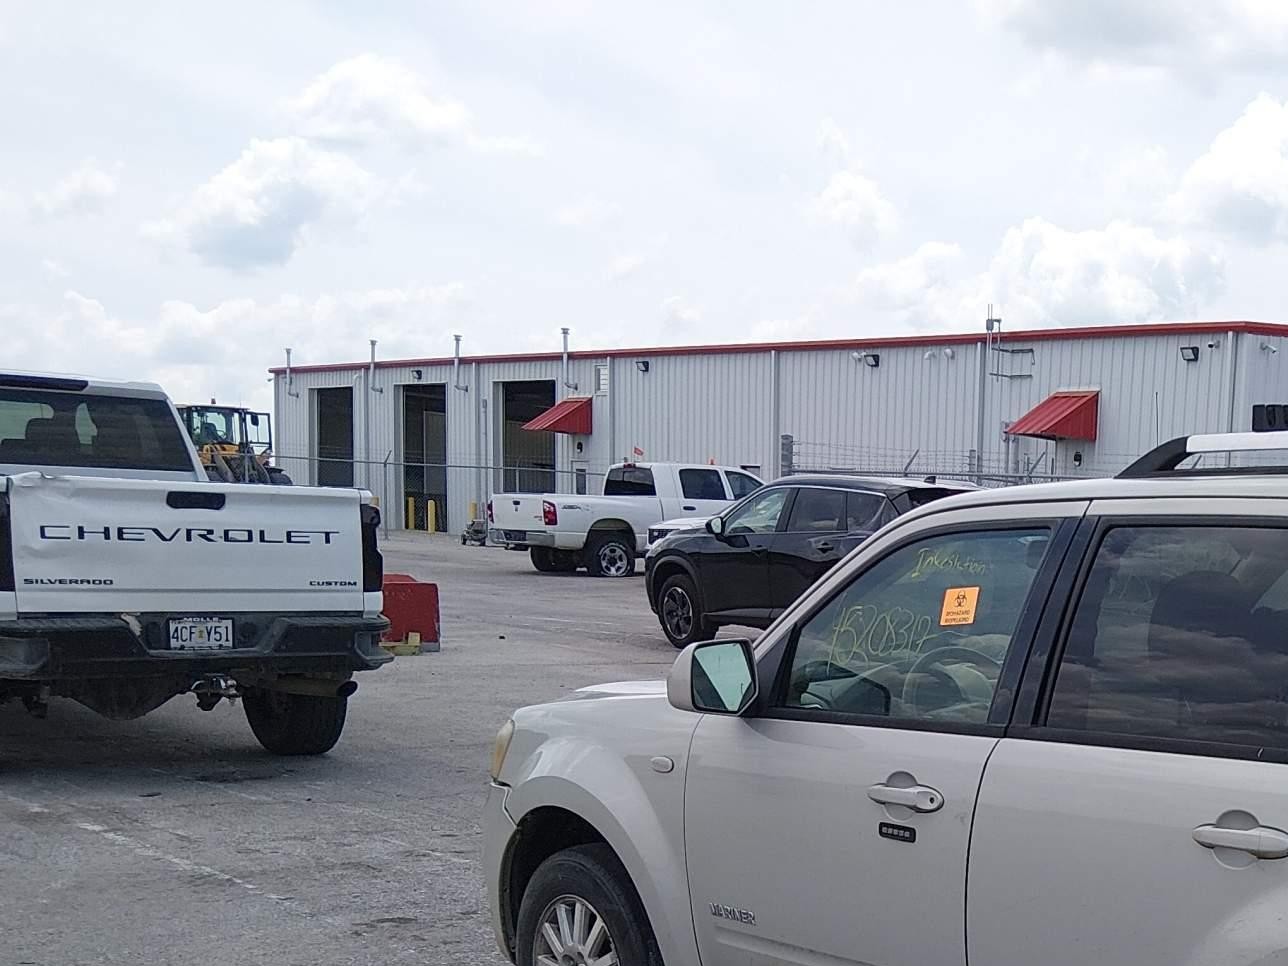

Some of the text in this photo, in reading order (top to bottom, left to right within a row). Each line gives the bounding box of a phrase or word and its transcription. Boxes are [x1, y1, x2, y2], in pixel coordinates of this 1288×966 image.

[40, 524, 340, 545] CHEVROLET
[23, 578, 114, 586] SILVERADO
[309, 580, 358, 588] CUSTOM
[171, 625, 230, 643] 4CF Y51
[709, 902, 756, 926] MARINER
